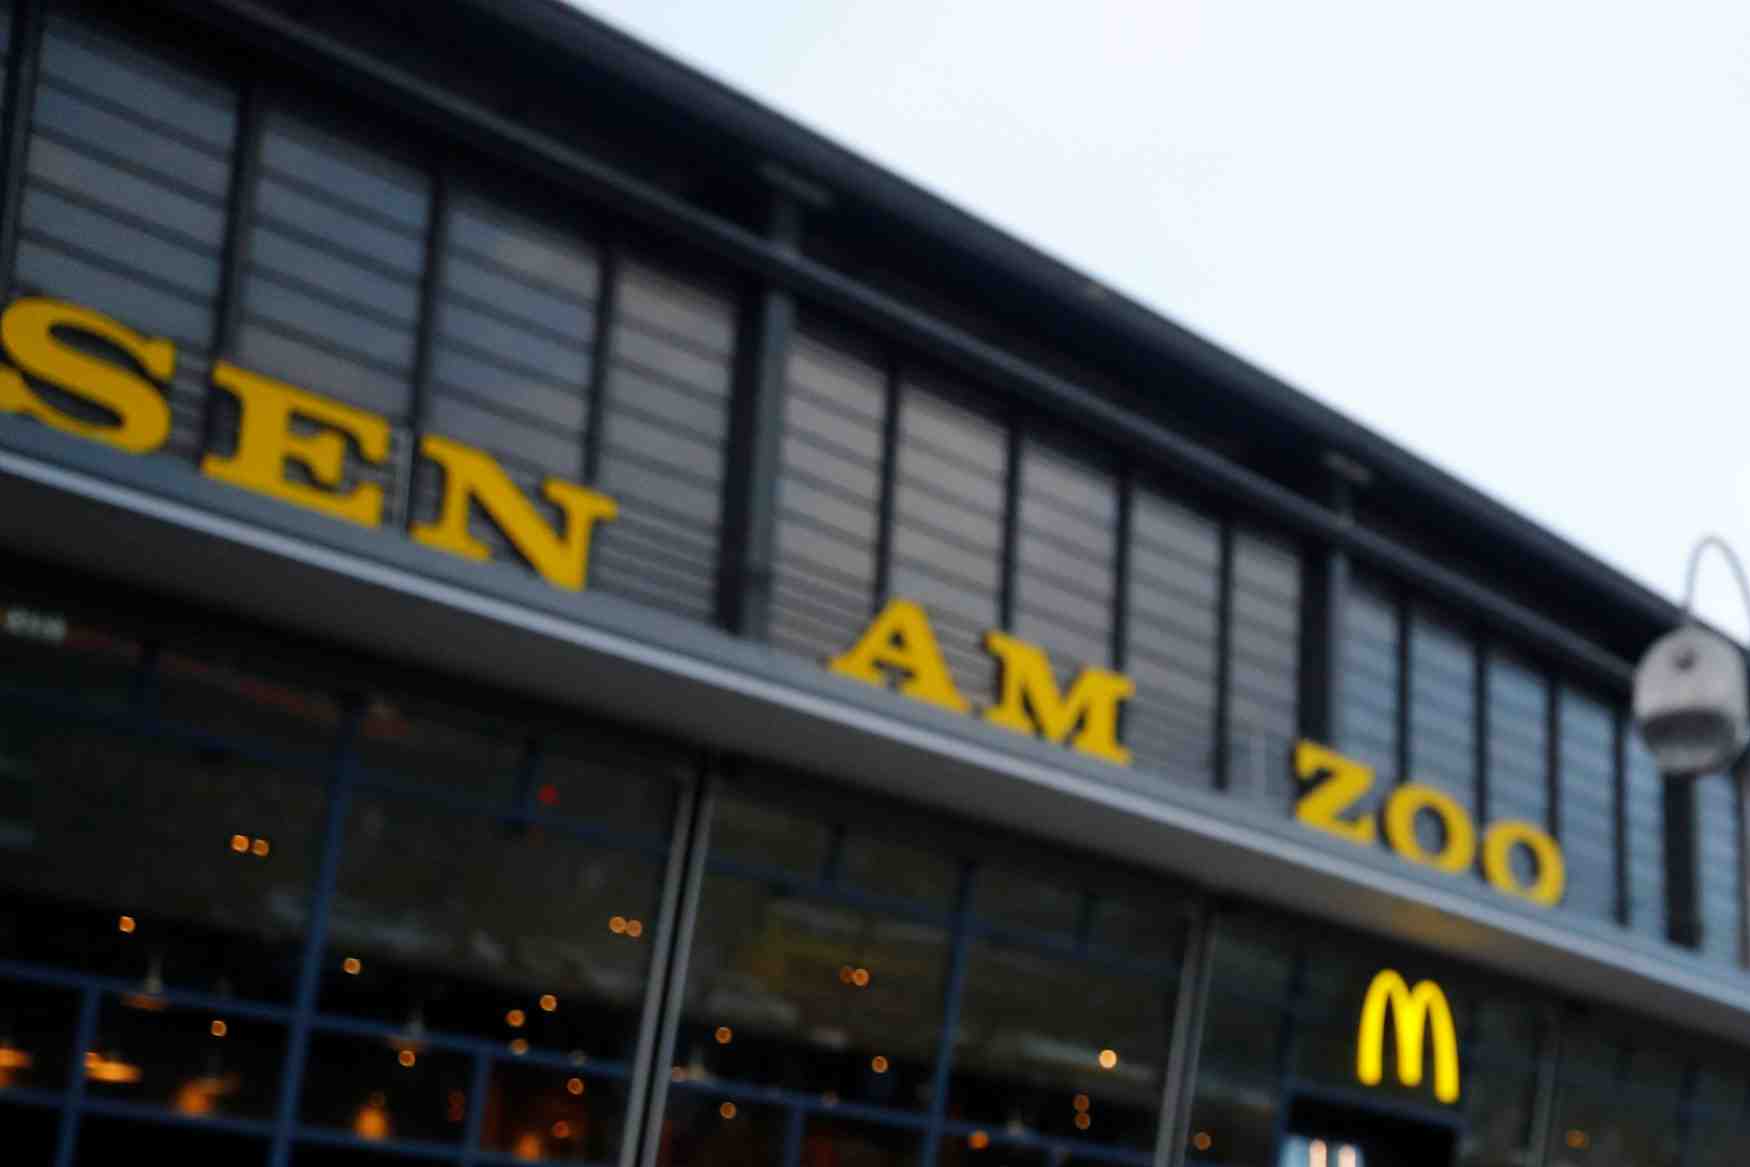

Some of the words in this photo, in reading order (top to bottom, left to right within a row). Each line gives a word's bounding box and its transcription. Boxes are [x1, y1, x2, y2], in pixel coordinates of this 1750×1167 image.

[0, 296, 618, 591] SEN
[829, 599, 1136, 765] AM
[1292, 738, 1566, 907] ZOO
